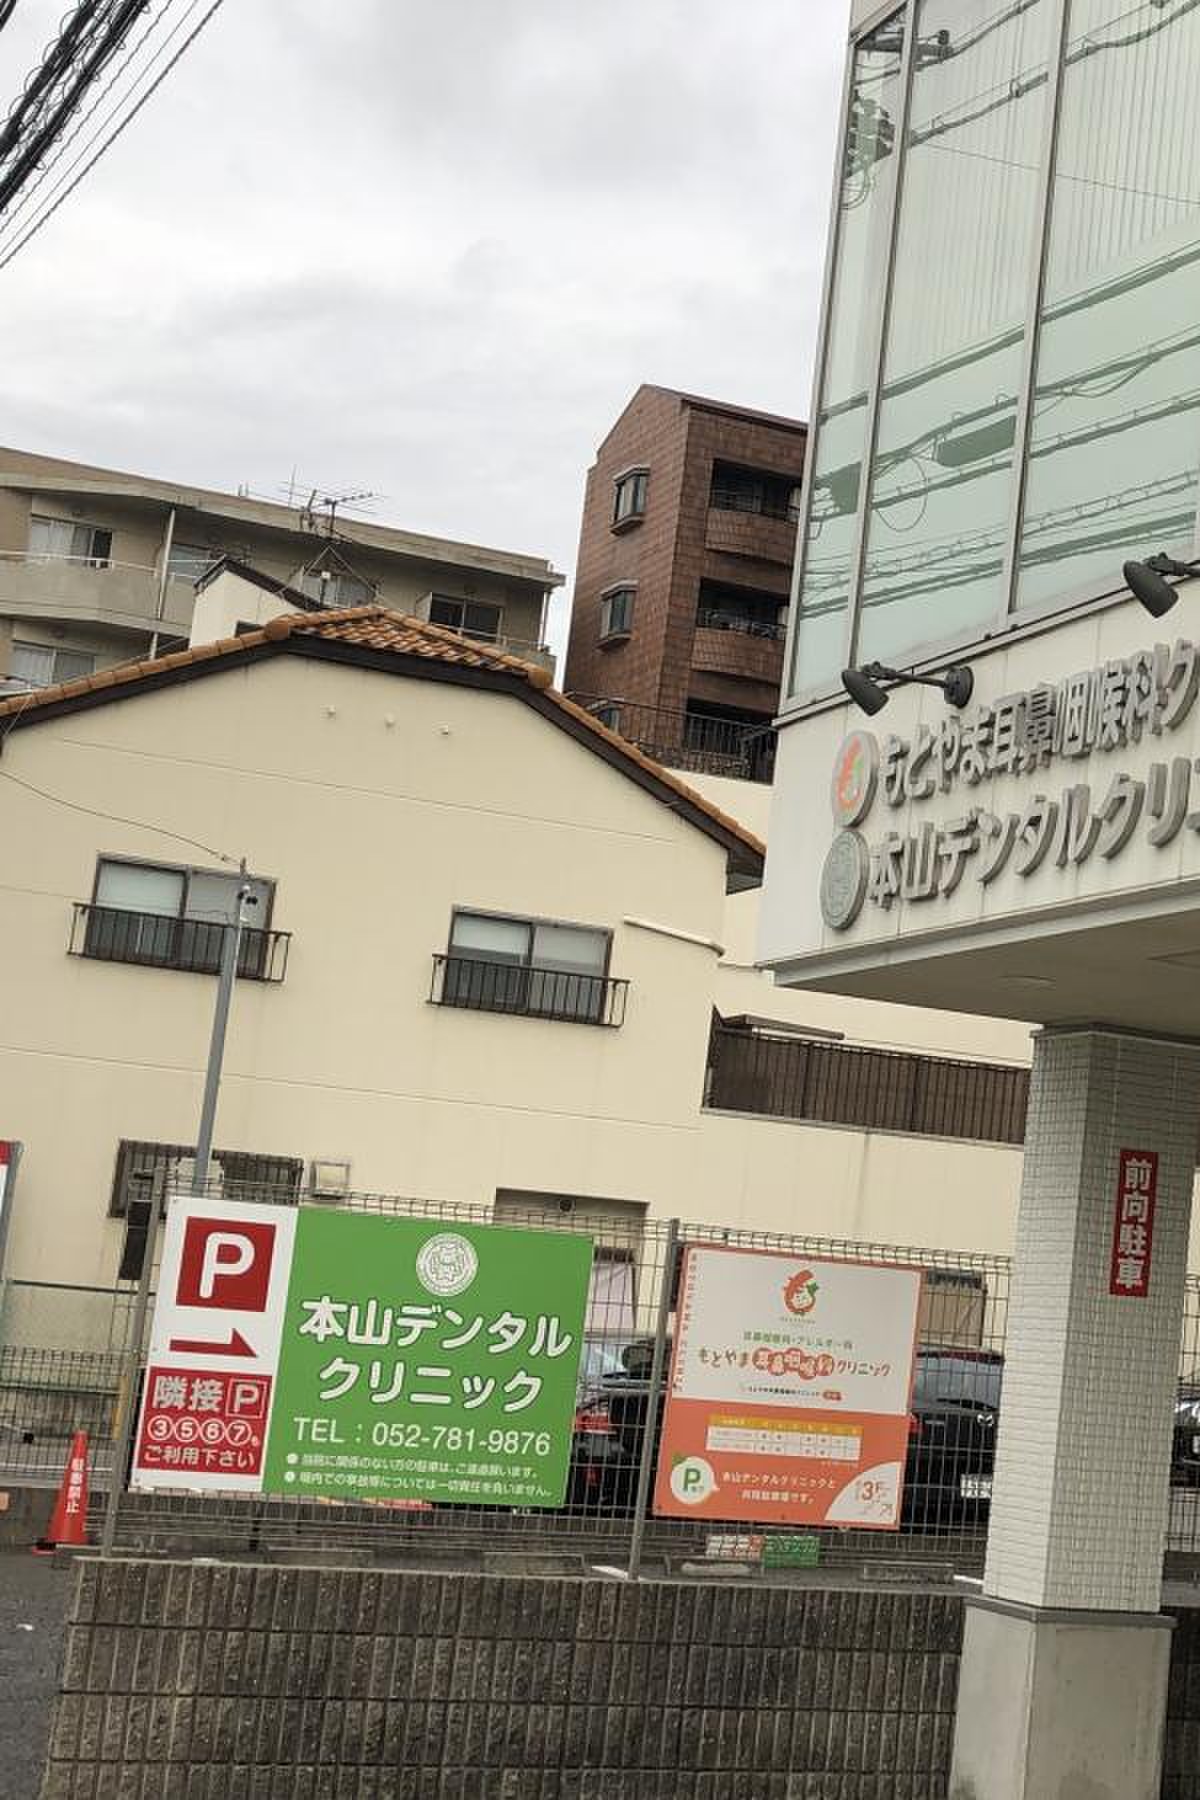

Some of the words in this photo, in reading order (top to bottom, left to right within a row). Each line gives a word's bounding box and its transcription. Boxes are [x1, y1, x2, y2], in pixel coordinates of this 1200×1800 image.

[1116, 1157, 1153, 1290] 前向駐車
[198, 1233, 256, 1298] P
[299, 1296, 573, 1359] 本山デンタル
[152, 1376, 224, 1412] 隣接
[318, 1357, 543, 1413] クリニック
[144, 1445, 255, 1467] ご利用下さい
[372, 1421, 551, 1455] 052-781-9876
[683, 1468, 702, 1491] P
